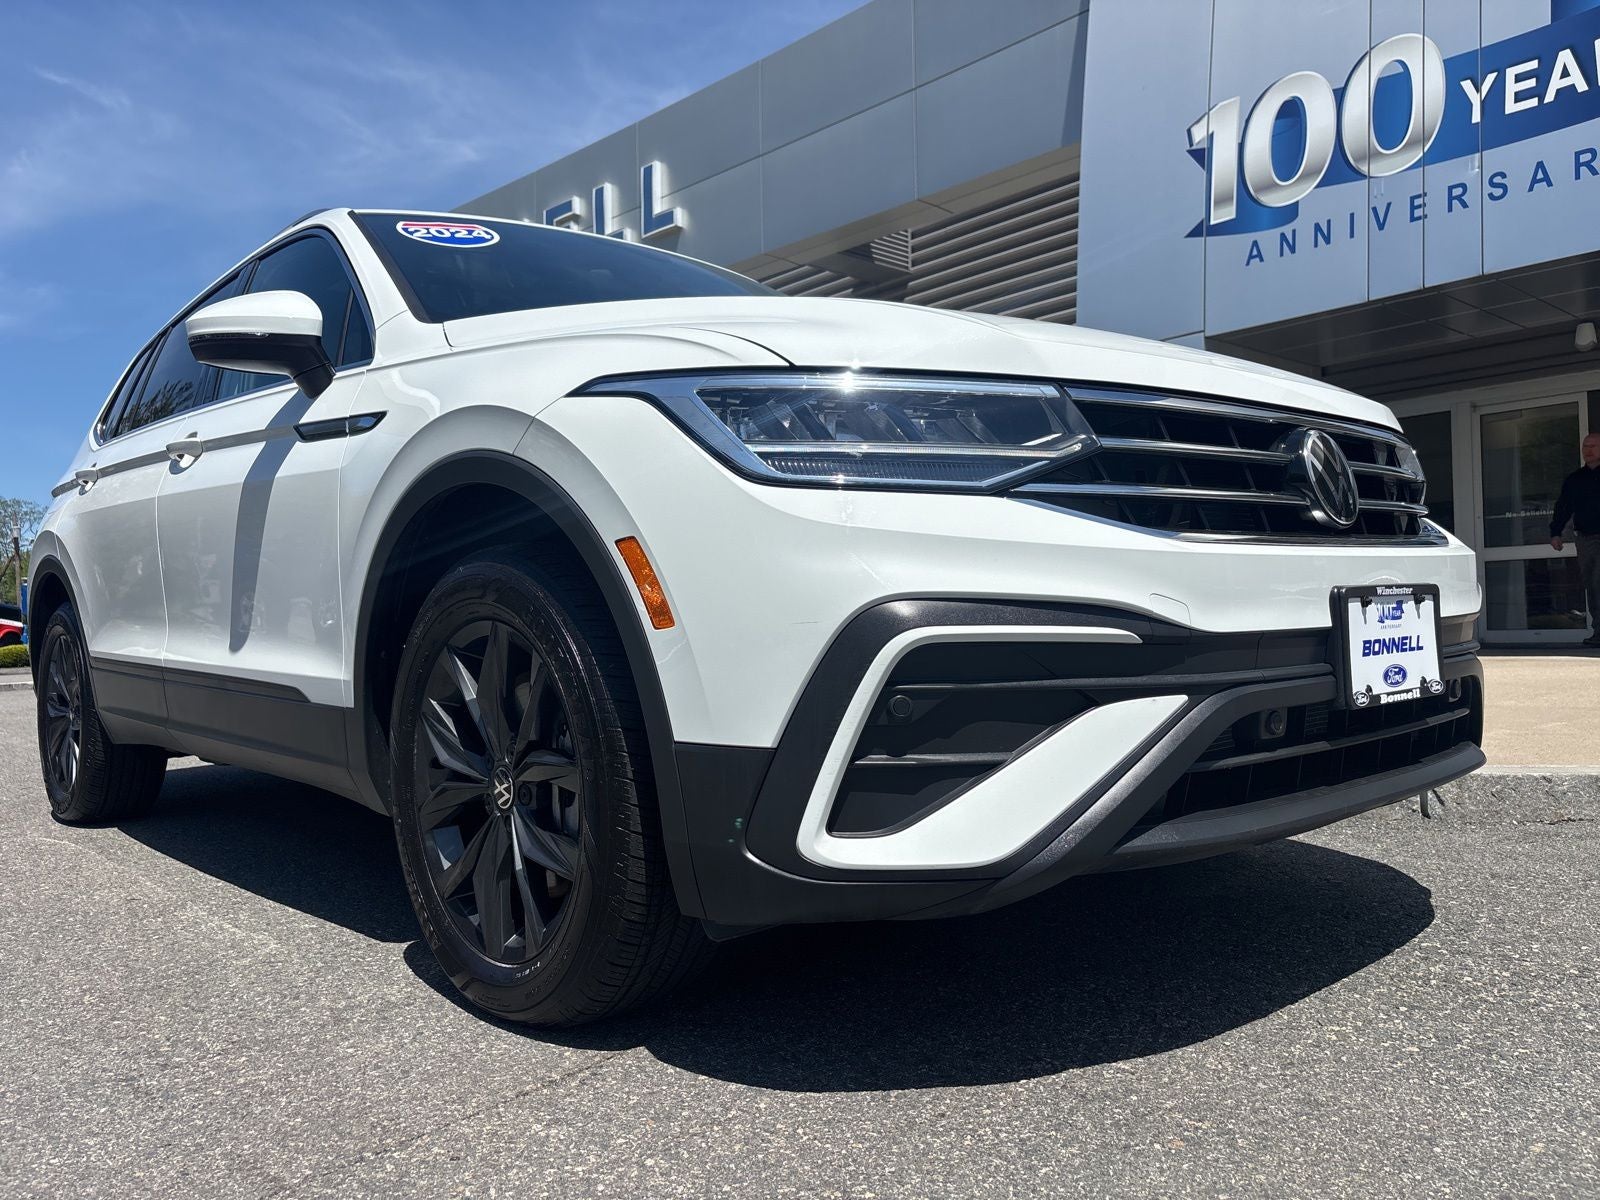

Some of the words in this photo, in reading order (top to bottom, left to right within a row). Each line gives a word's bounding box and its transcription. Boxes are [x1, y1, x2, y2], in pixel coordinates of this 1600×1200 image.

[1187, 33, 1446, 225] 100
[1460, 38, 1600, 124] YEA
[408, 227, 493, 240] 2024
[1376, 586, 1413, 596] Winchester
[1362, 635, 1424, 657] BONNELL
[1380, 688, 1421, 704] Bonnell
